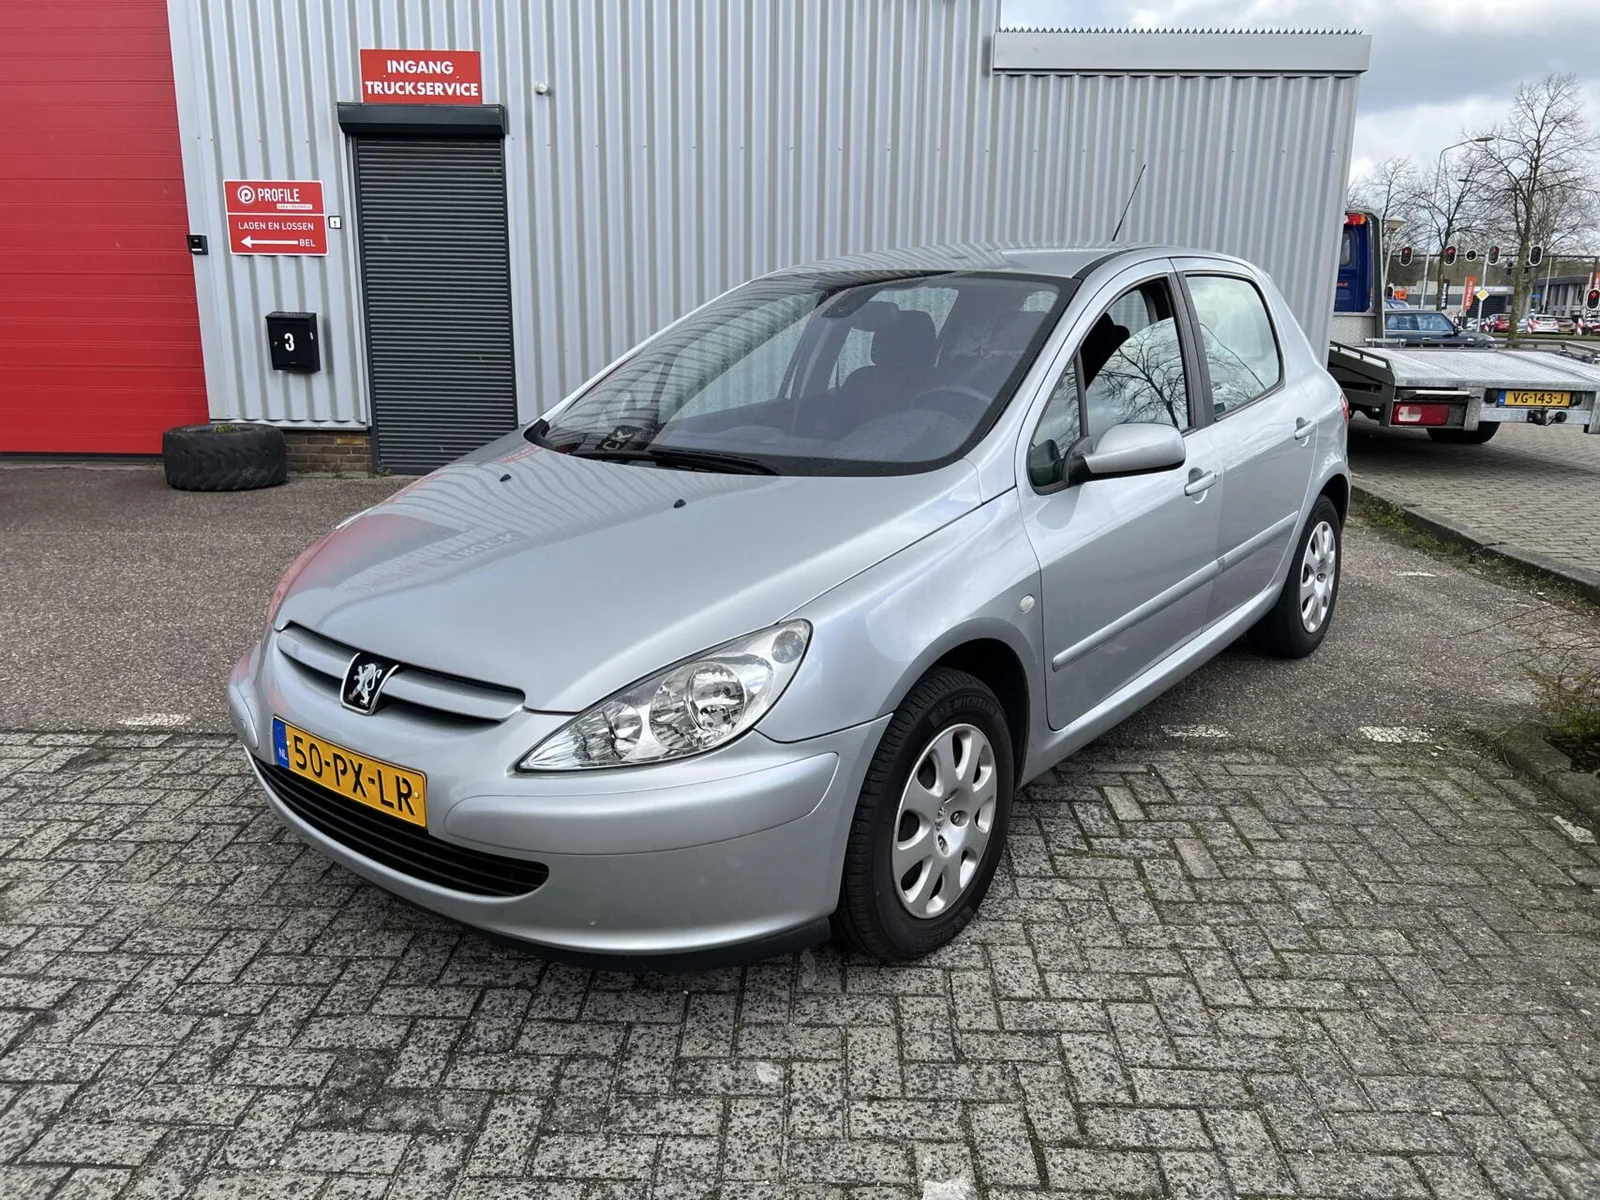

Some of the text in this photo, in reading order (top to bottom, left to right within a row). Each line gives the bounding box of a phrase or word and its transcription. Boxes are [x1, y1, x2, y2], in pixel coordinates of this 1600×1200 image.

[386, 60, 454, 75] INGANG
[365, 81, 479, 96] TRUCKSERVICE
[257, 188, 300, 202] PROFILE
[238, 222, 314, 231] LADEN EN LOSSEN
[299, 238, 316, 247] BEL
[284, 332, 295, 352] 3
[1513, 392, 1564, 404] VG-143-J
[278, 746, 288, 761] NL
[293, 734, 416, 816] 50-PX-LR
